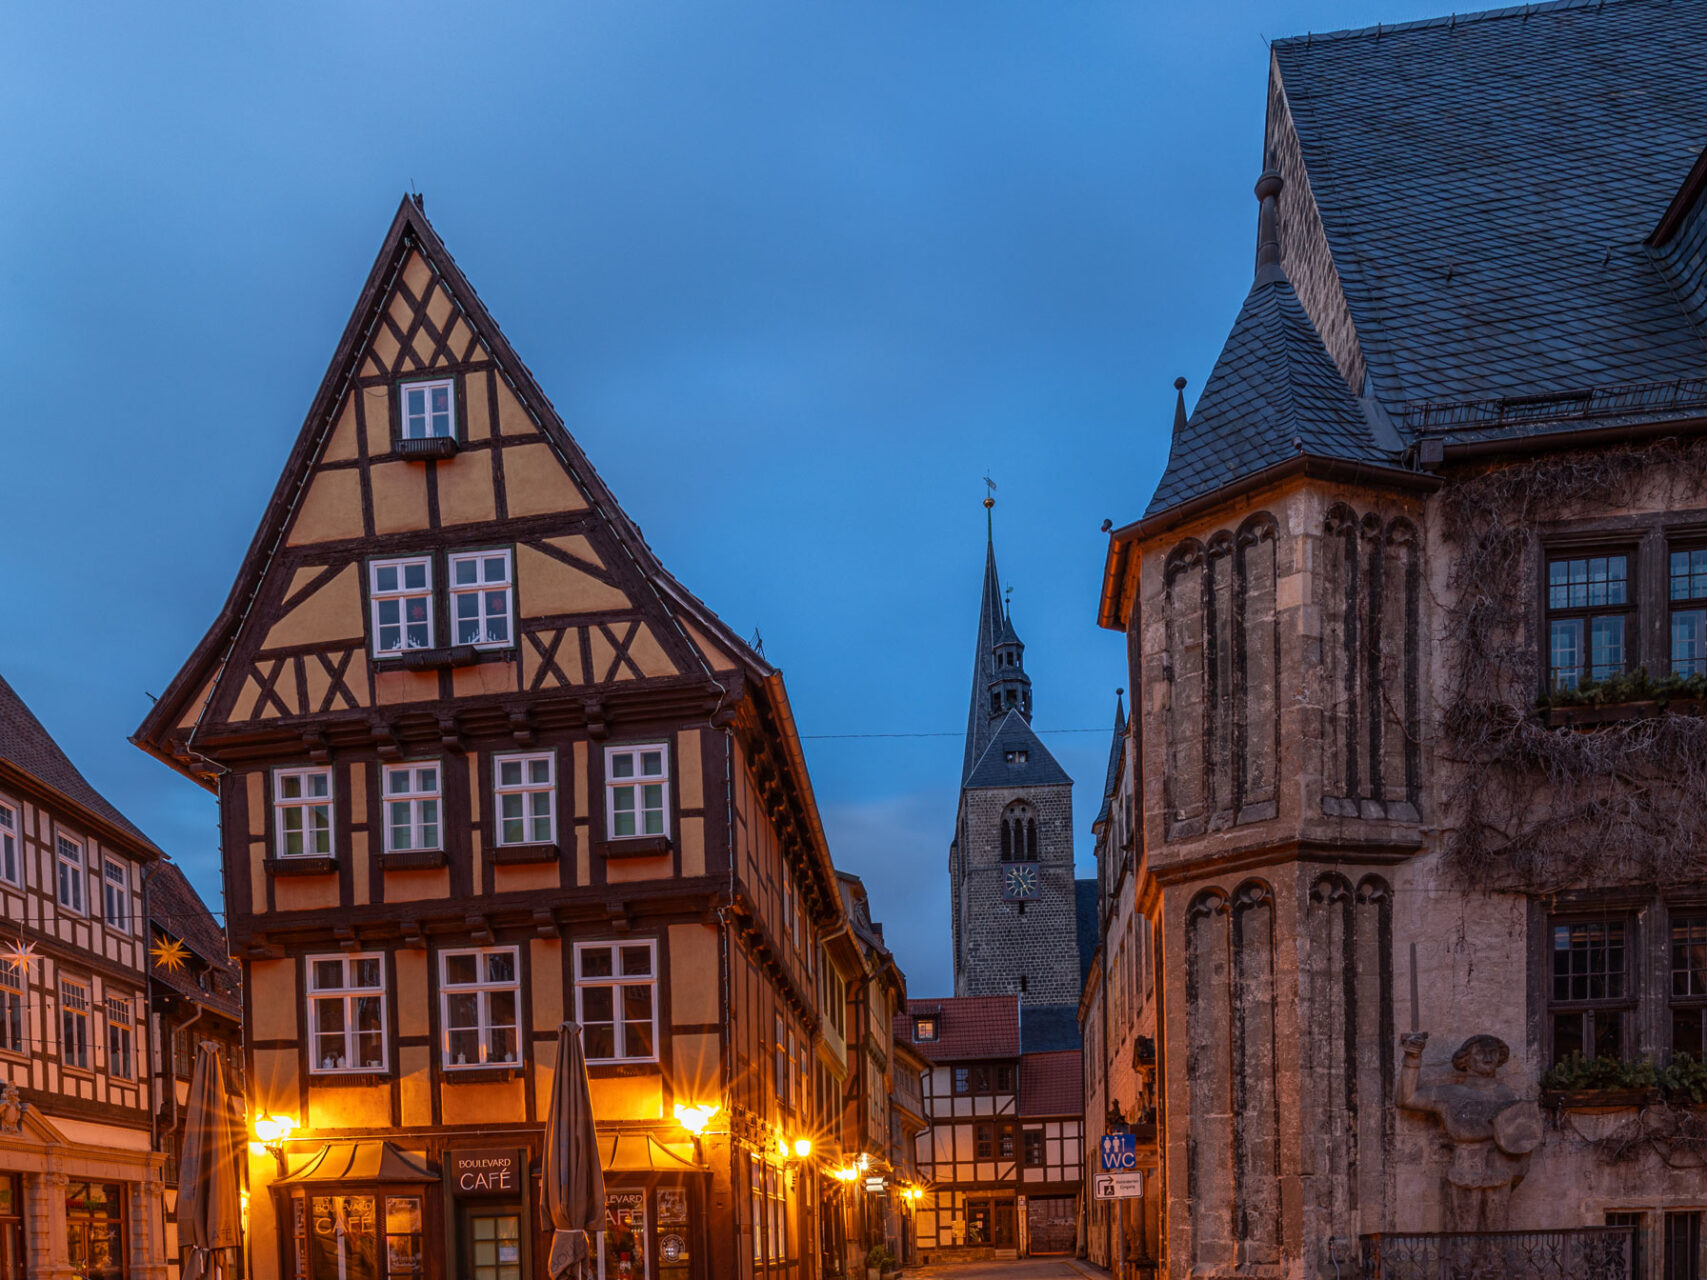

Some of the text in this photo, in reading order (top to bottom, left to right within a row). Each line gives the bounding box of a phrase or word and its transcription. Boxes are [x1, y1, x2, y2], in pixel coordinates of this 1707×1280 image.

[458, 1158, 511, 1169] BOULEVARD
[1104, 1152, 1135, 1168] WC
[460, 1168, 511, 1190] CAFÉ
[315, 1200, 373, 1213] BOUVARD
[606, 1194, 643, 1204] LEVARD
[606, 1203, 643, 1226] AFÉ
[315, 1212, 374, 1234] CAFÉ
